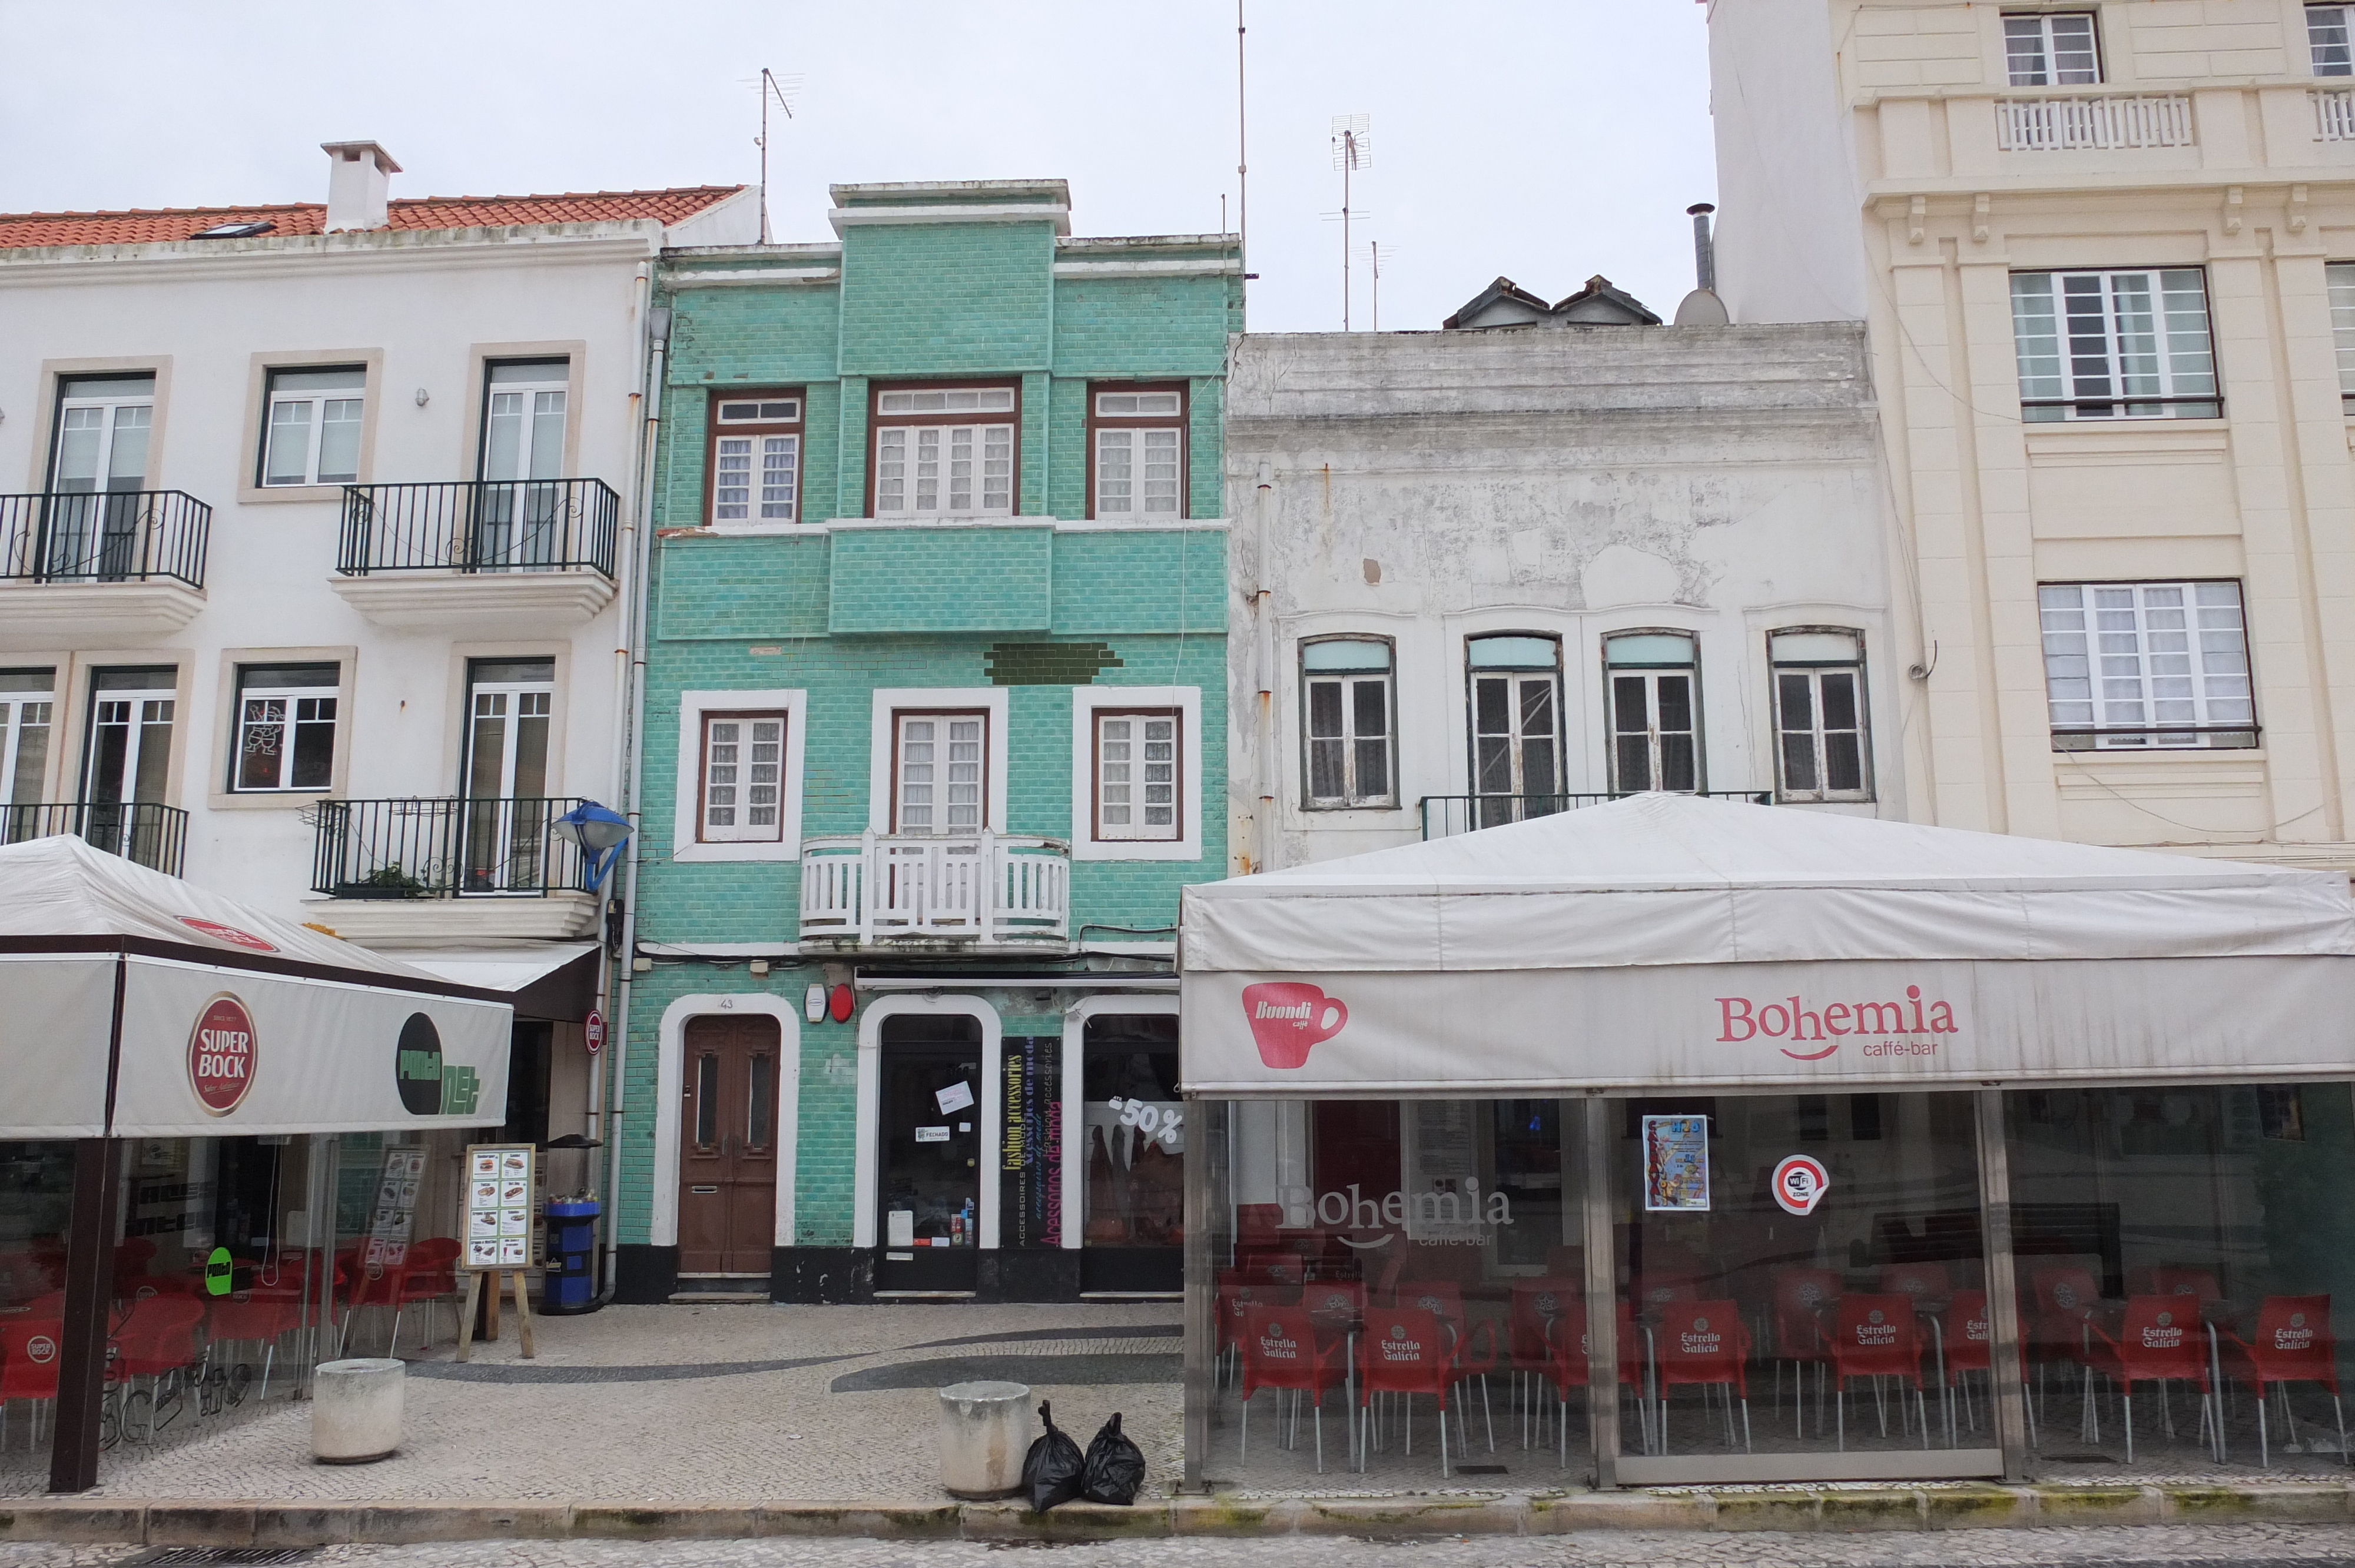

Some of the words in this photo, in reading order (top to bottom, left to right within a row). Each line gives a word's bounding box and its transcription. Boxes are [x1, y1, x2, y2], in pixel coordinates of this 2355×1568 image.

[720, 999, 733, 1009] 43
[1255, 1001, 1312, 1019] Buondi
[1714, 984, 1959, 1042] Bohemia
[200, 1029, 249, 1054] SUPER
[1862, 1040, 1939, 1057] caffé-bar
[1024, 1037, 1034, 1076] moda
[198, 1054, 246, 1078] BOCK
[1007, 1055, 1022, 1122] accessories
[1024, 1078, 1033, 1095] de
[1002, 1126, 1021, 1170] fashion
[1275, 1176, 1514, 1229] Bohemia
[1856, 1324, 1896, 1335] Estrella
[1966, 1320, 1988, 1330] Estr
[1681, 1332, 1720, 1343] Estrella
[1966, 1329, 1989, 1340] Gali
[2142, 1326, 2182, 1337] Estrella
[2274, 1328, 2313, 1338] Estrella
[1260, 1336, 1296, 1348] Estrella
[1381, 1340, 1421, 1351] Estrella
[1858, 1334, 1895, 1345] Galicia
[2142, 1337, 2181, 1348] Galicia
[2274, 1338, 2310, 1350] Galicia
[1263, 1347, 1296, 1358] Galicia
[1682, 1342, 1719, 1353] Galicia
[1384, 1349, 1420, 1361] Galicia
